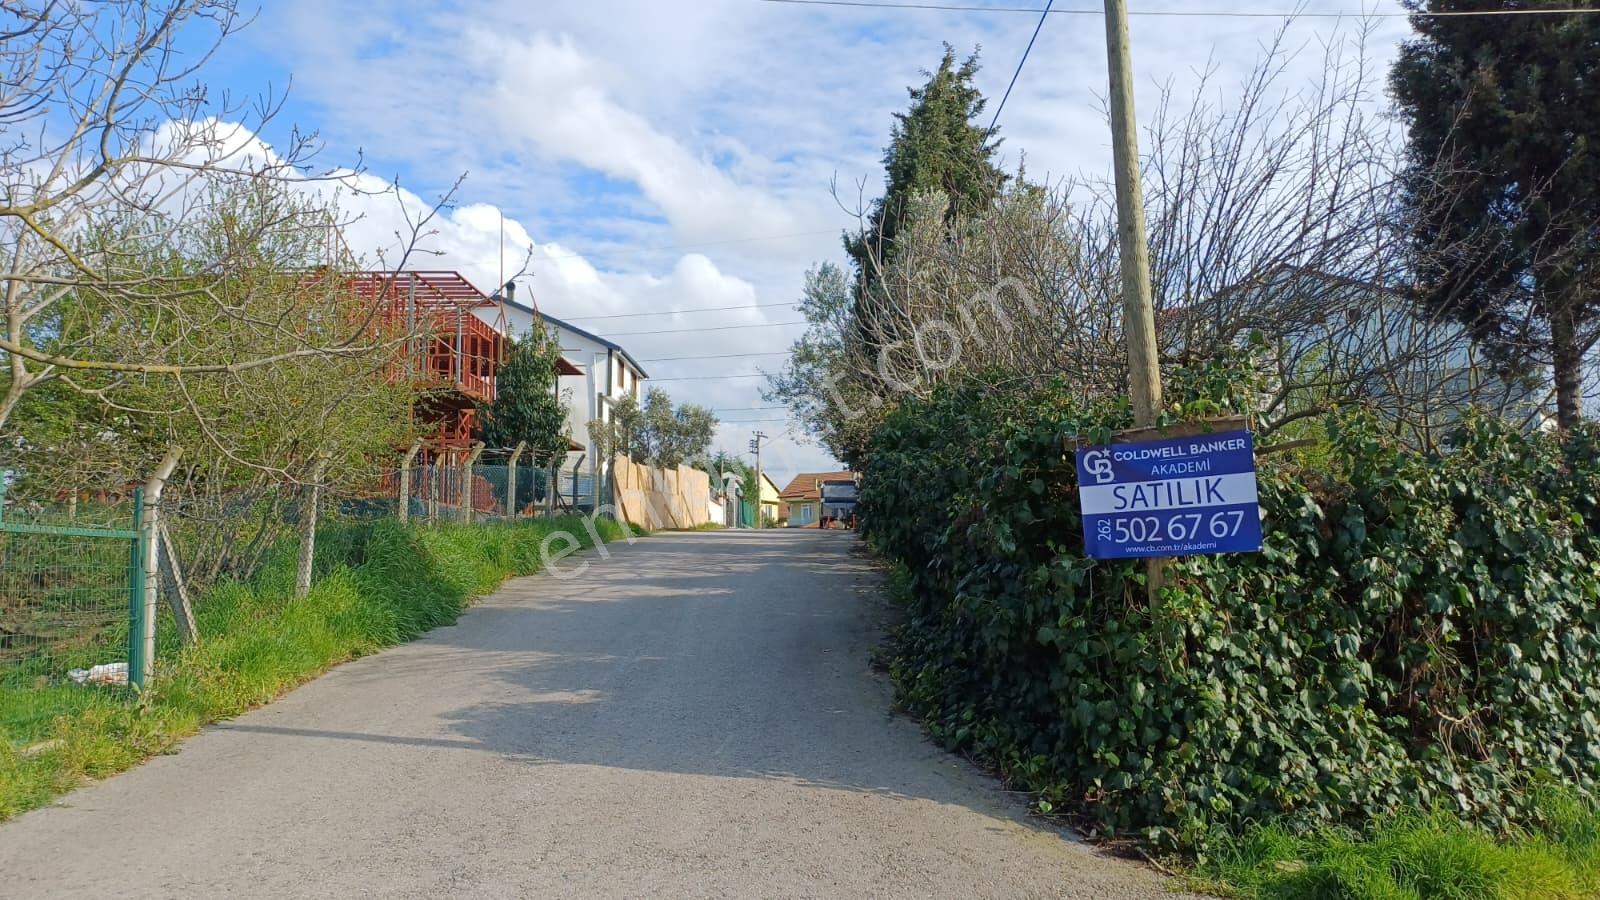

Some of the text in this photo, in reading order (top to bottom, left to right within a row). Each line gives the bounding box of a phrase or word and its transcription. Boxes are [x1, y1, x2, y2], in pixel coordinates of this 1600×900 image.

[1113, 438, 1246, 462] COLDWELL BANKER
[1083, 450, 1115, 484] CB
[1151, 458, 1211, 476] AKADEMİ
[1112, 477, 1225, 510] SATILIK
[1097, 518, 1112, 541] 262
[1115, 510, 1245, 543] 502 67 67
[1125, 541, 1217, 553] www.cb.com.tr/akademi
